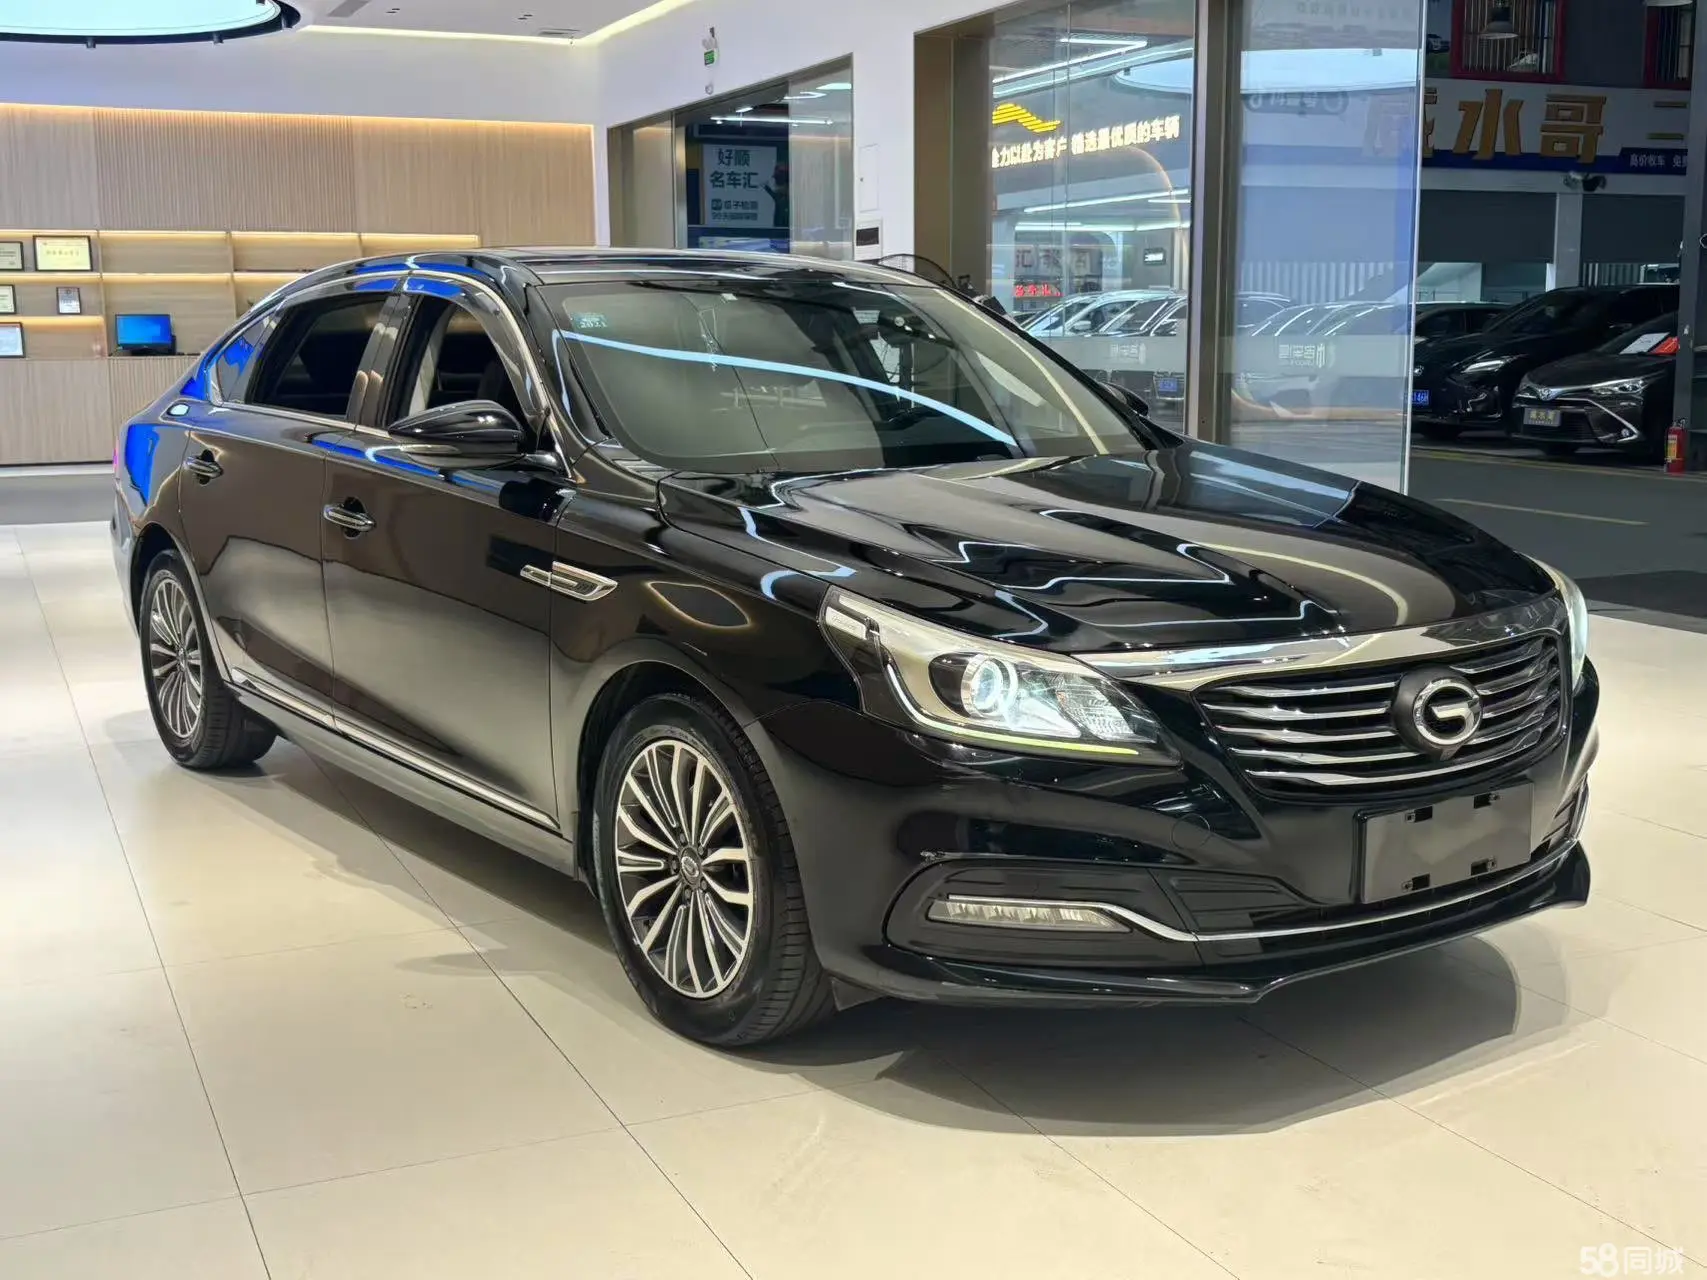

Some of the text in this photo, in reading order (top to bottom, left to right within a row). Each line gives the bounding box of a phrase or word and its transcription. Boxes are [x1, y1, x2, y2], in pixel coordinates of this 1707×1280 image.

[718, 148, 751, 167] 好顺
[710, 170, 759, 189] 名车汇
